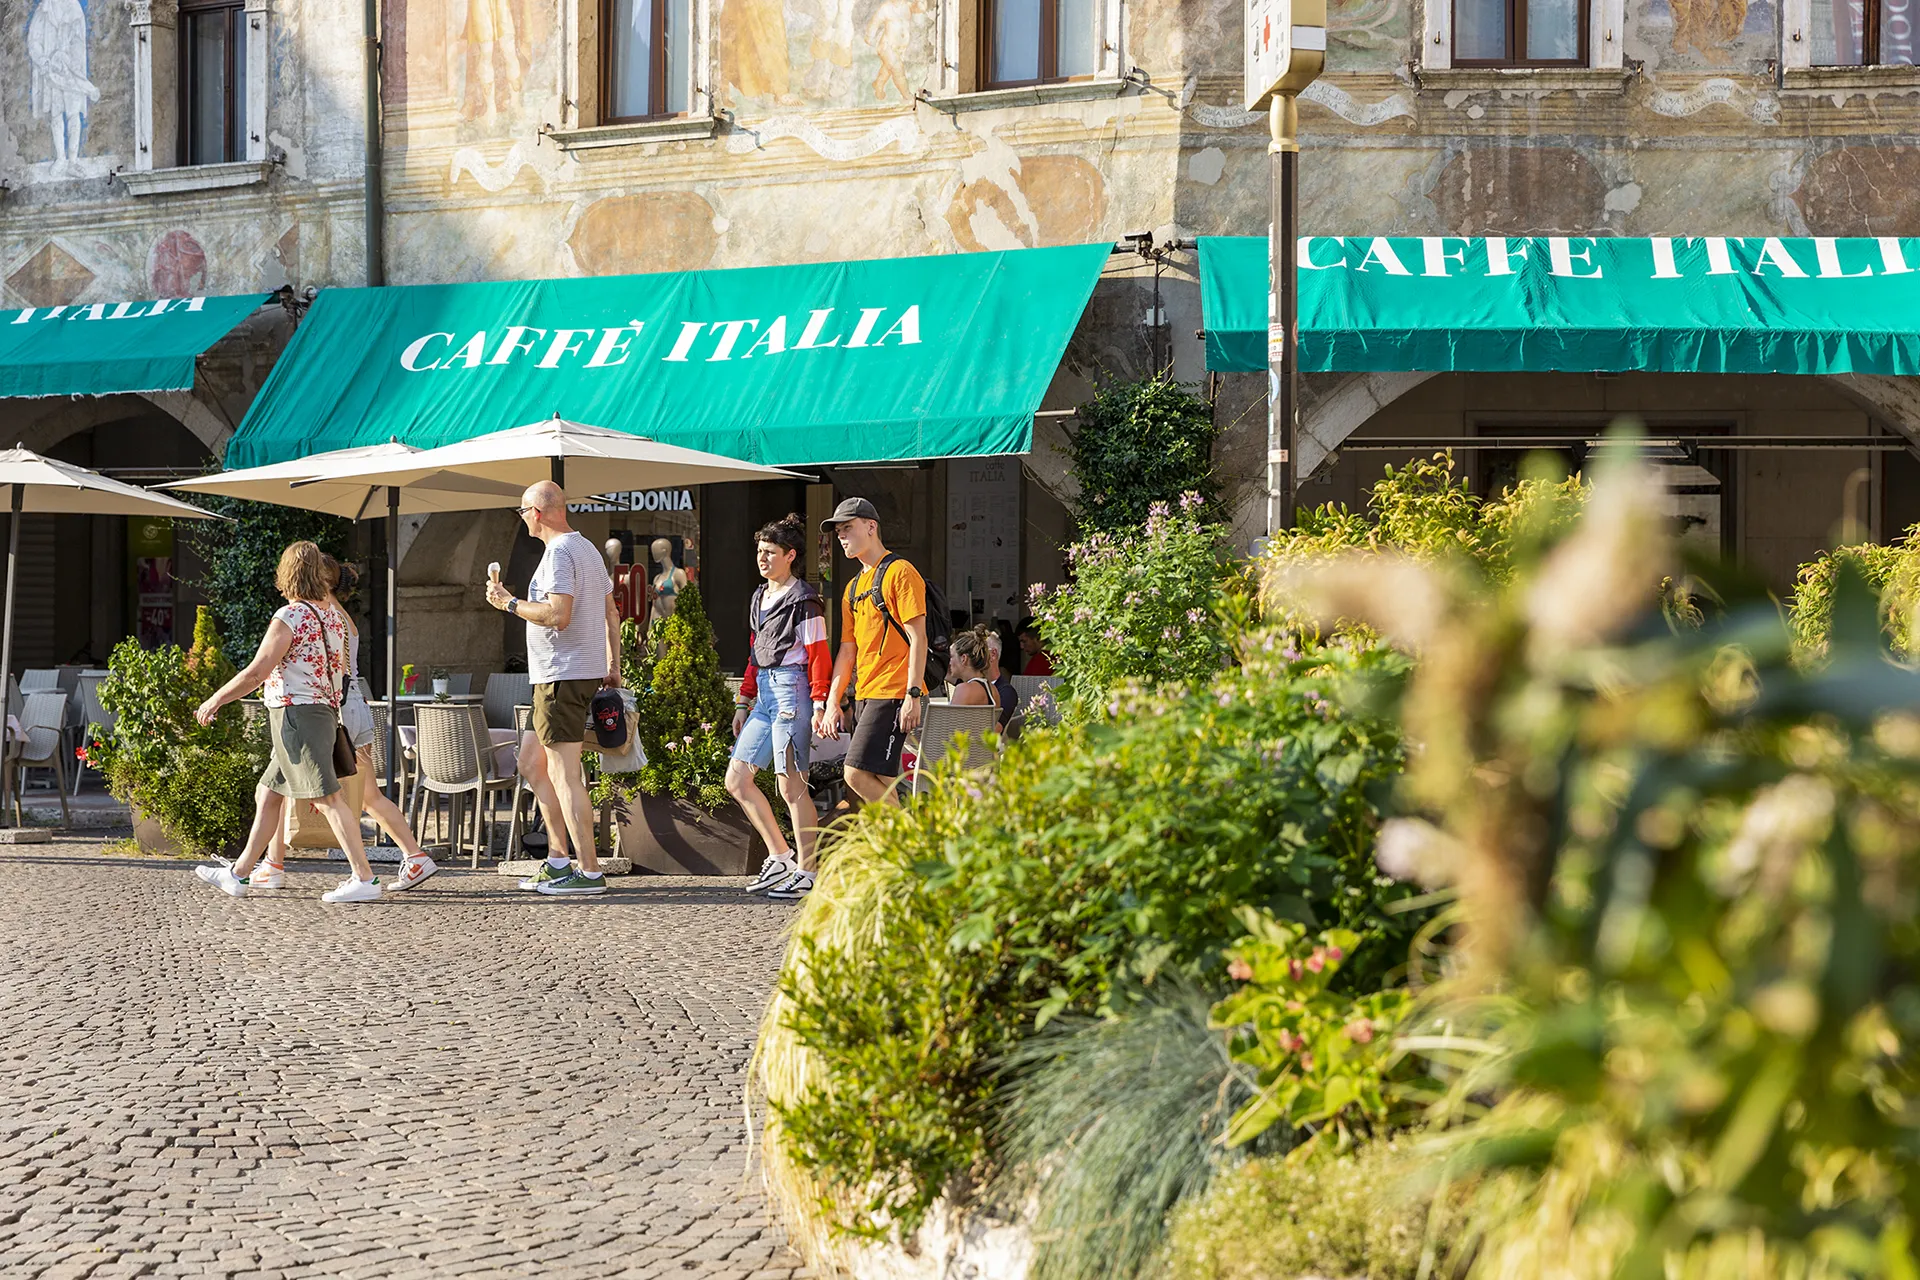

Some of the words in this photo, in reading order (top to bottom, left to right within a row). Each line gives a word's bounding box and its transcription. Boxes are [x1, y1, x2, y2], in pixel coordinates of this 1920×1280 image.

[1650, 236, 1920, 277] ITALI
[400, 318, 645, 372] CAFFÈ
[661, 304, 922, 362] ITALIA
[969, 470, 1005, 483] ITALIA
